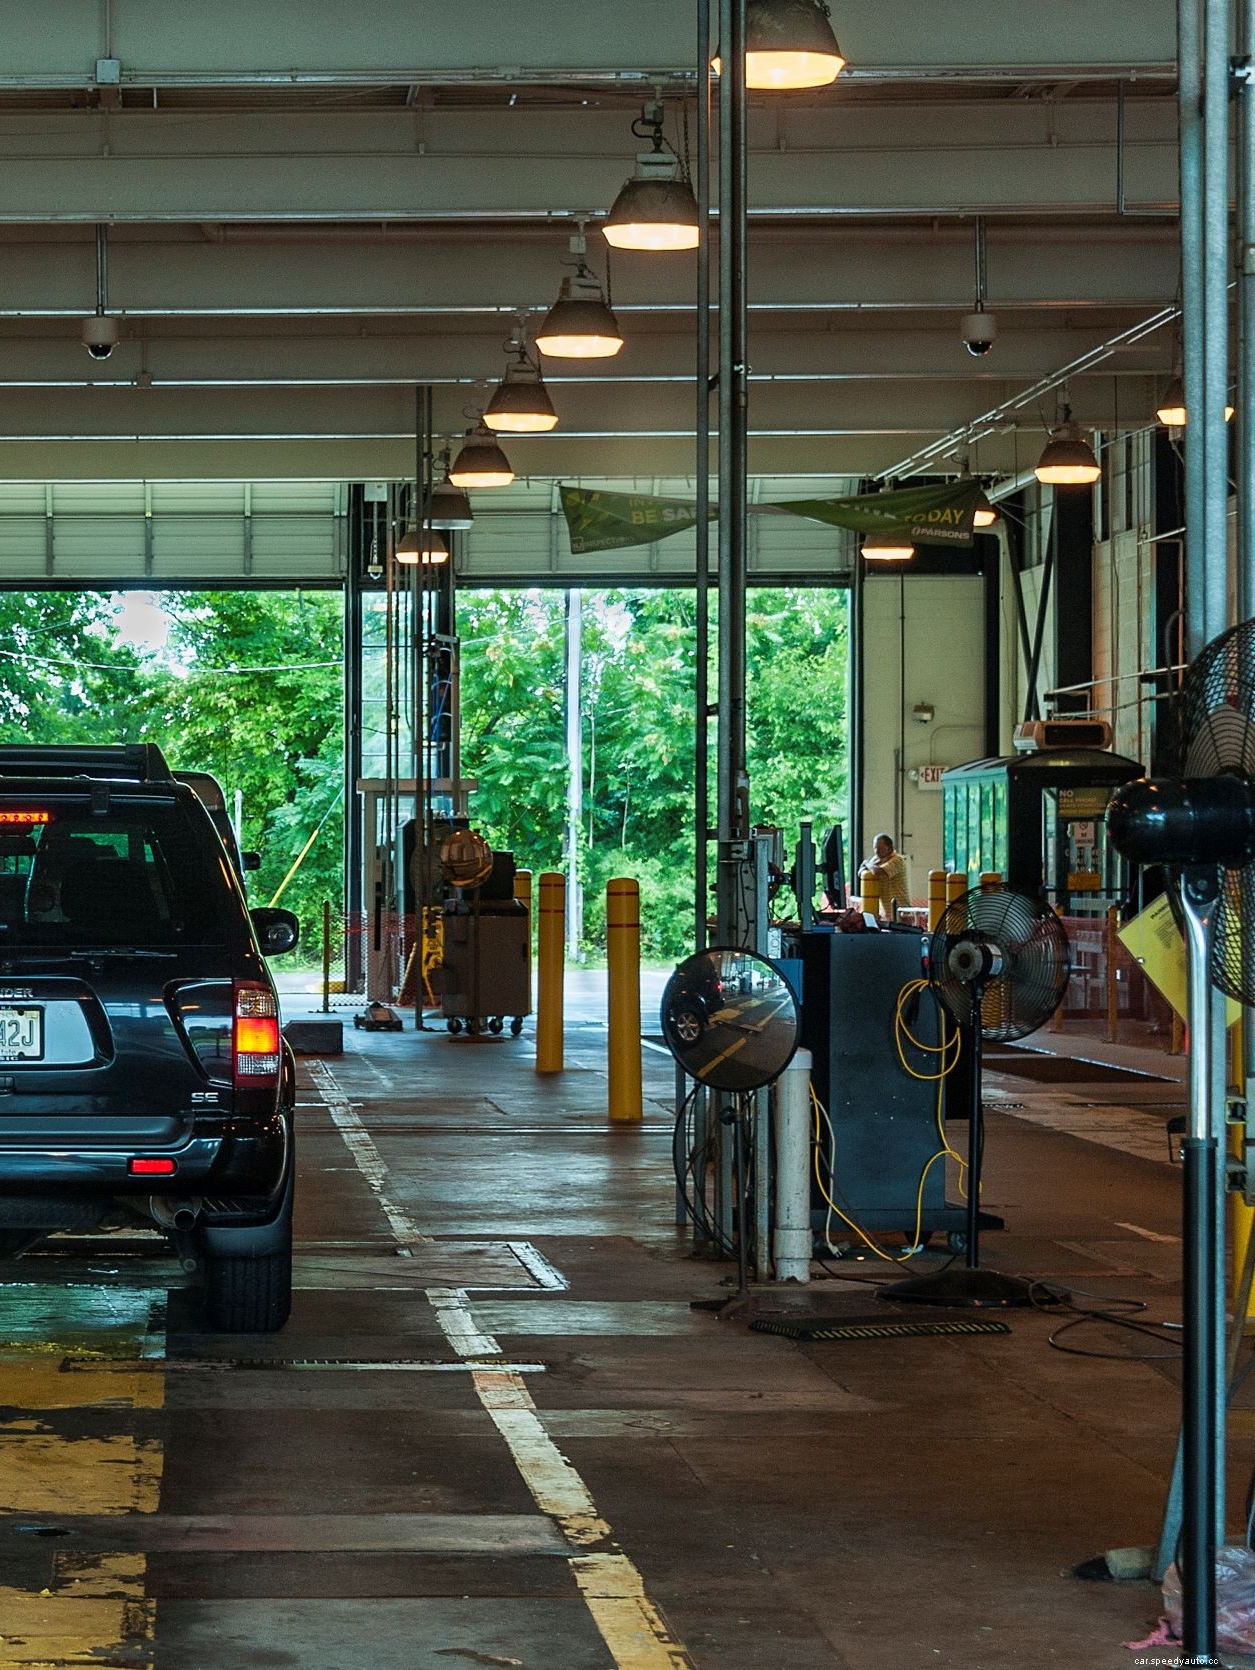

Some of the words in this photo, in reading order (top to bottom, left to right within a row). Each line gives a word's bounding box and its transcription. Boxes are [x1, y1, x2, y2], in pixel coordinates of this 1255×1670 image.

[632, 510, 658, 525] BE
[1059, 790, 1074, 798] NO
[191, 1092, 219, 1103] SE
